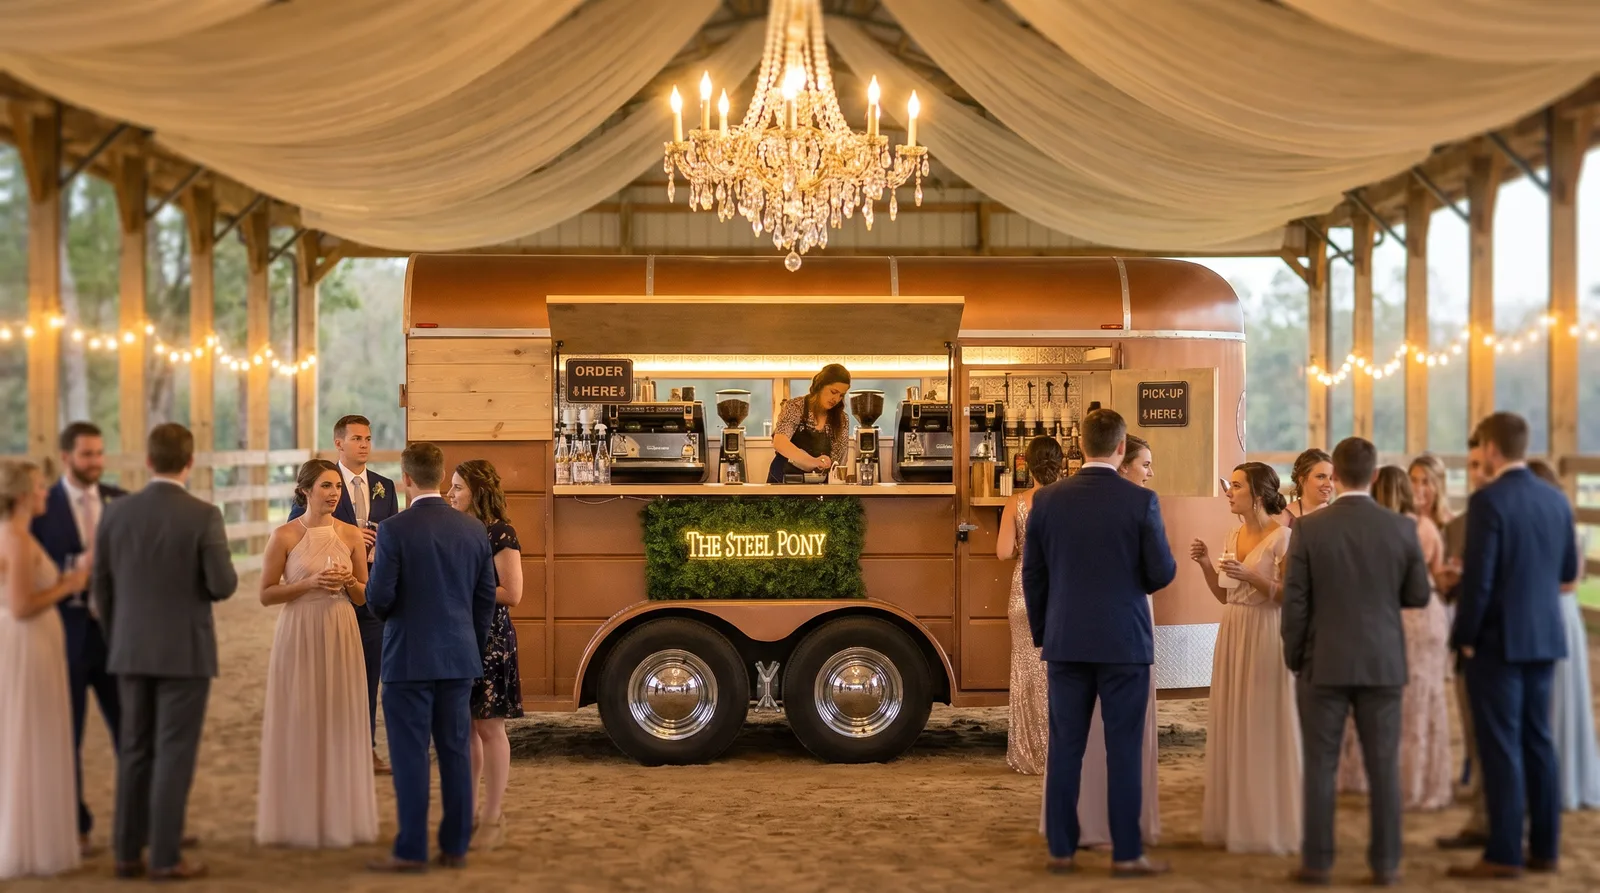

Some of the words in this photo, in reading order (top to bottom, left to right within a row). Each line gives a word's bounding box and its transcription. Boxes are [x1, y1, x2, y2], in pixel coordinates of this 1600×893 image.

[575, 366, 623, 377] ORDER
[581, 386, 618, 397] HERE
[1142, 389, 1184, 399] PICK-UP
[1150, 409, 1177, 419] HERE
[686, 531, 722, 557] THE
[725, 531, 774, 557] STEEL
[776, 530, 826, 556] PONY
